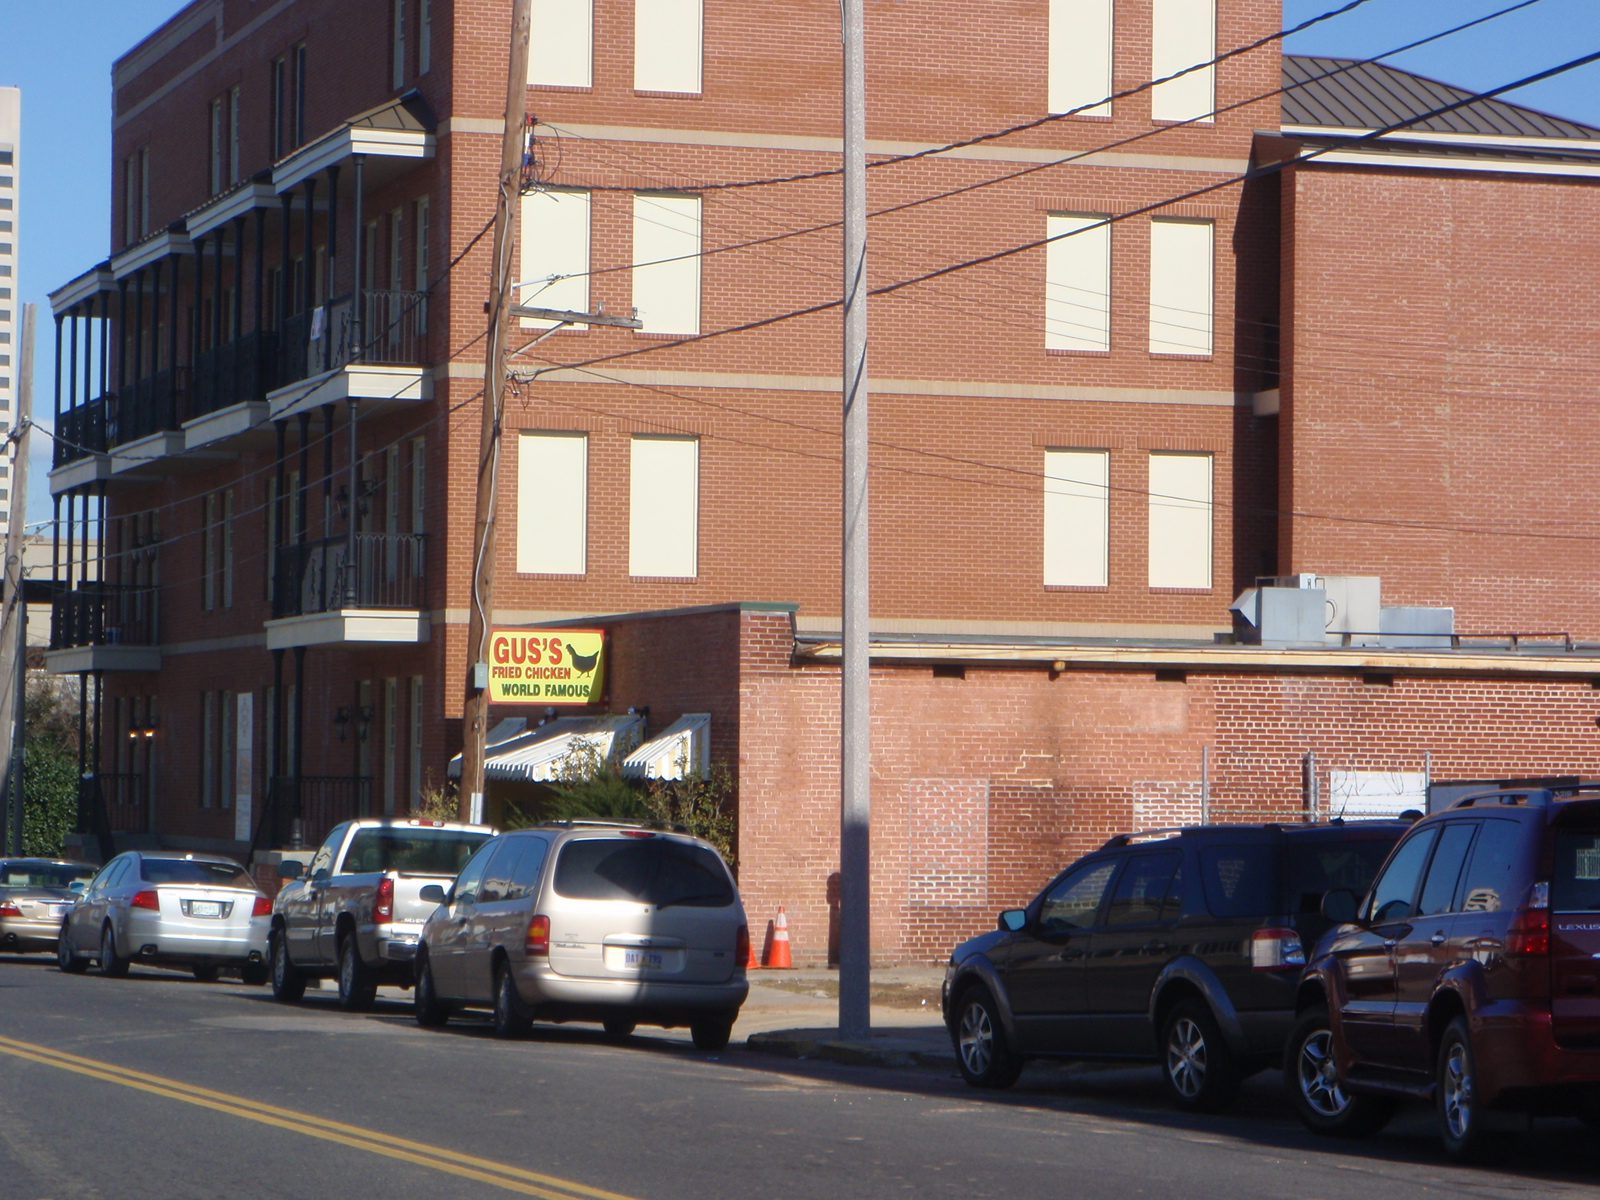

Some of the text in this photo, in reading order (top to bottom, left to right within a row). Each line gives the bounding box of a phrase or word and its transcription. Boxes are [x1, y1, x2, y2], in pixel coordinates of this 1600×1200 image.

[494, 637, 562, 664] GUS'S
[492, 666, 571, 679] FRIED CHICKEN
[502, 683, 590, 697] WORLD FAMOUS
